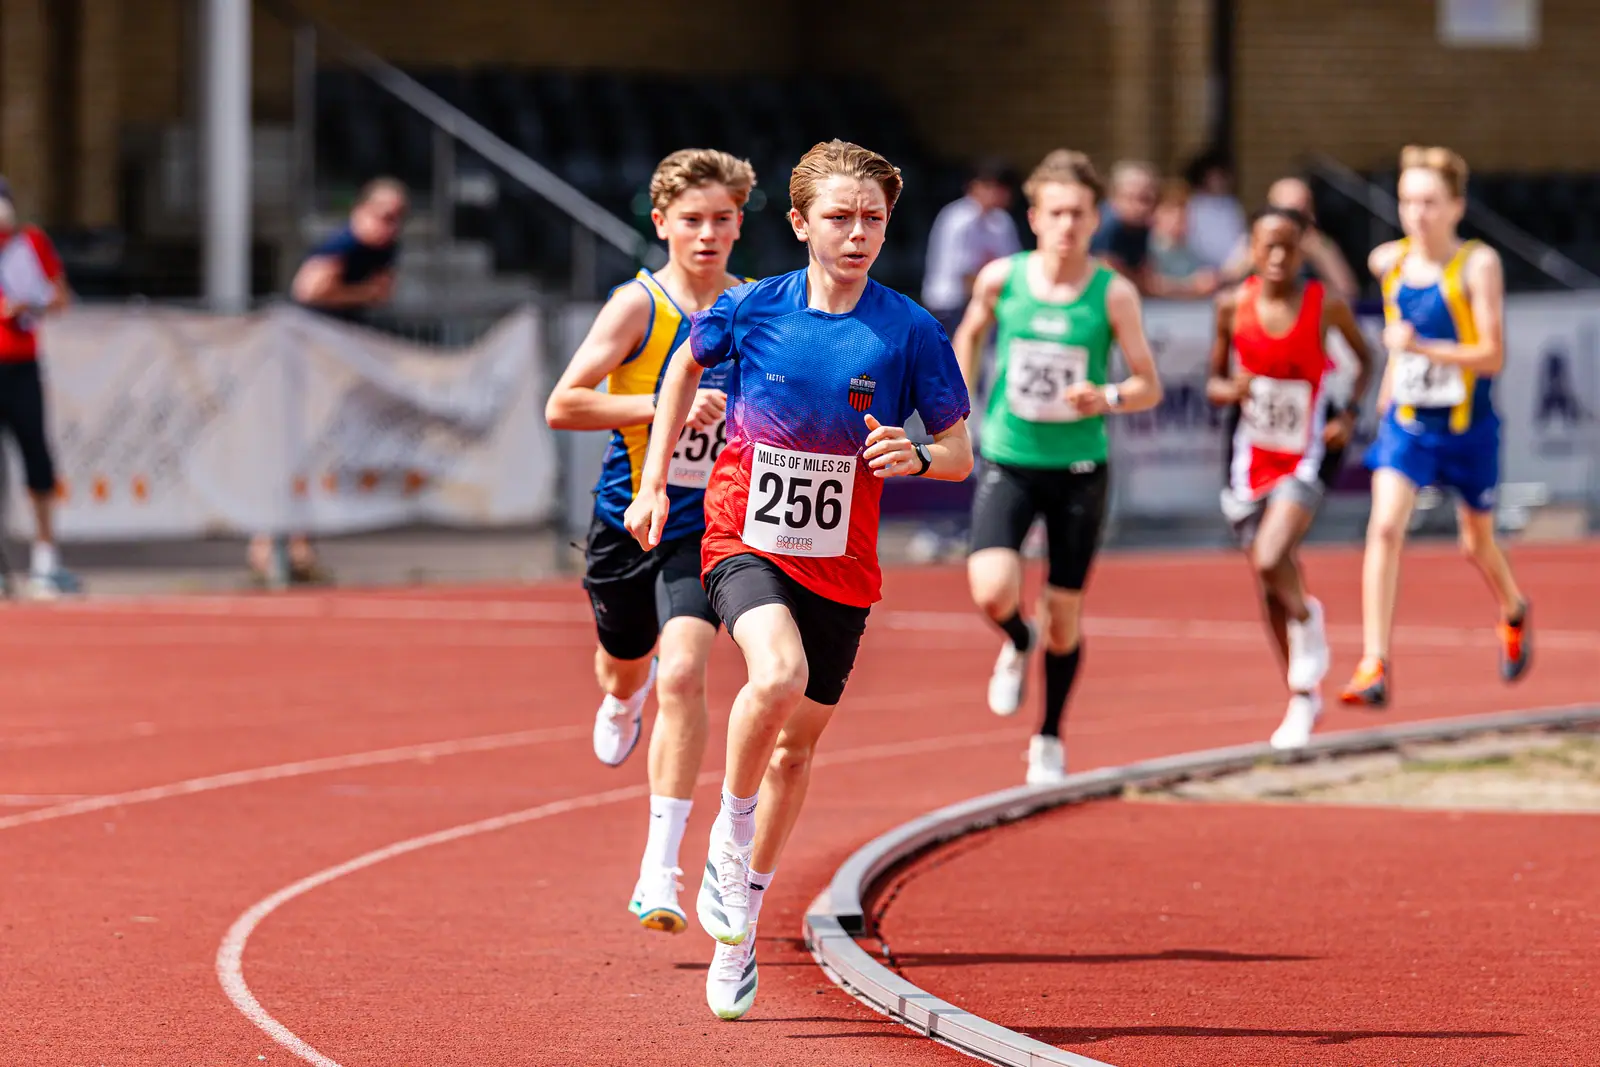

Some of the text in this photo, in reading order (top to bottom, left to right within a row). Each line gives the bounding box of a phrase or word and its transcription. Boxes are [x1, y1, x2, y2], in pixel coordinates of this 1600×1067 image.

[766, 373, 785, 383] TACTIC
[672, 419, 728, 463] 58
[758, 449, 851, 474] MILES OF MILES 26
[754, 472, 843, 530] 256
[776, 541, 813, 551] express
[777, 535, 813, 545] comms
